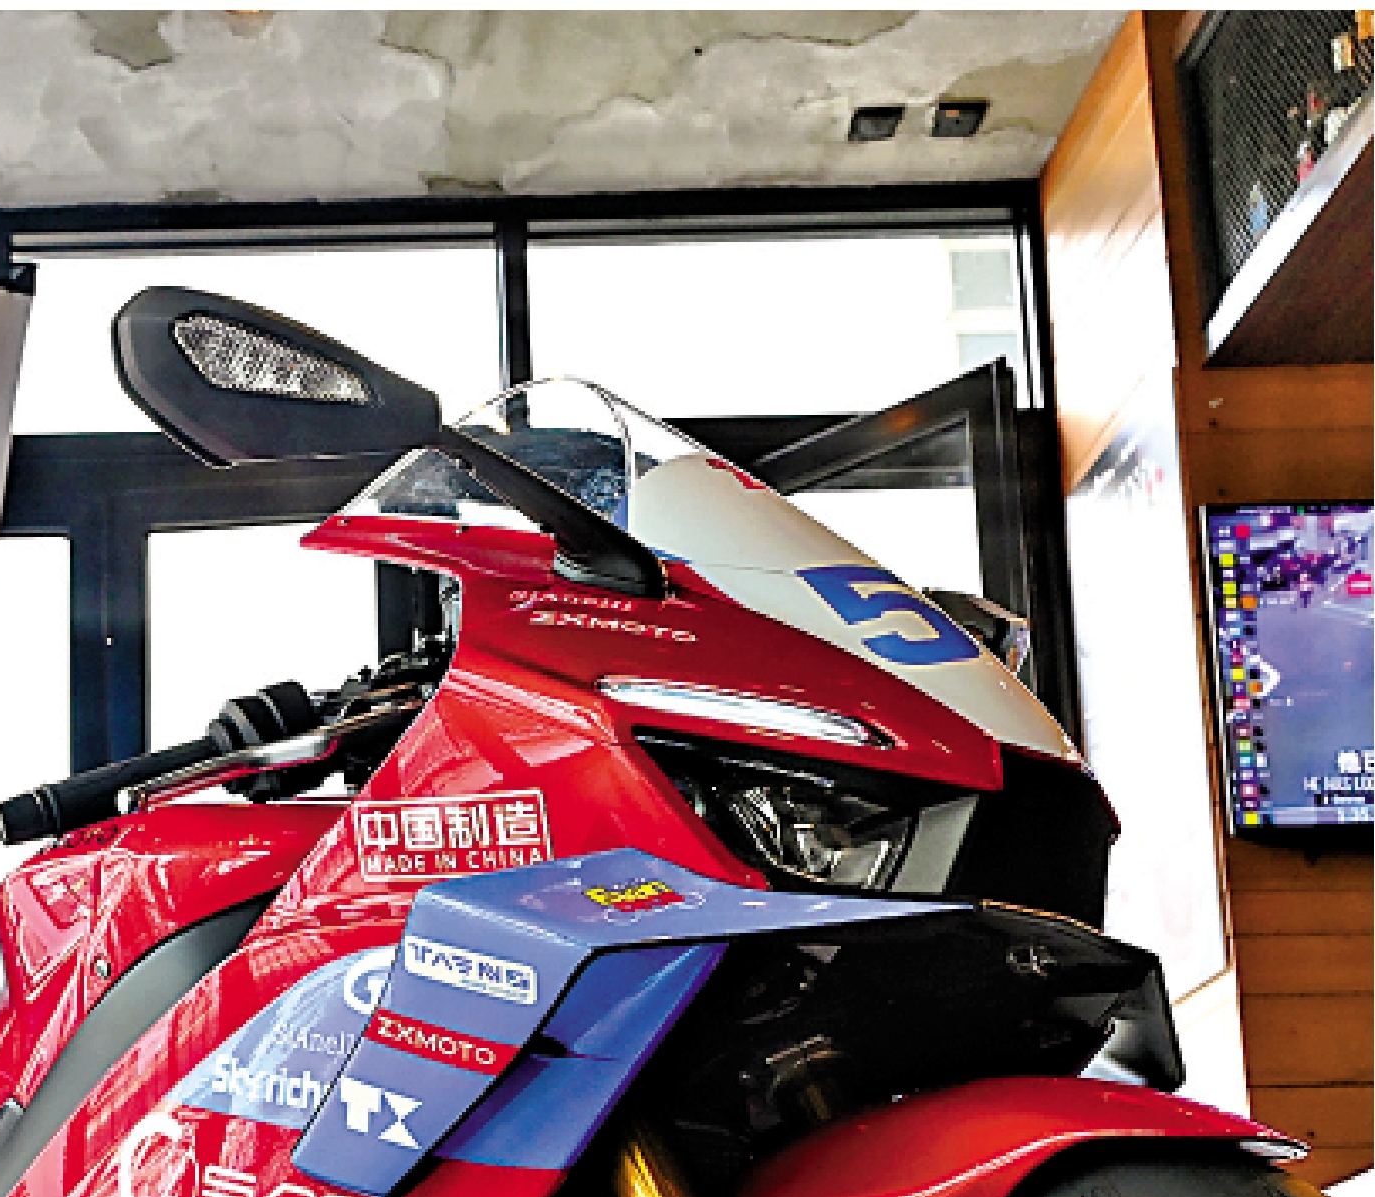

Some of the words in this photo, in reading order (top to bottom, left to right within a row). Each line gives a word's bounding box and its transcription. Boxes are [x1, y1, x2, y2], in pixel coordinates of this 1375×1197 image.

[529, 610, 698, 643] ZXMOTO
[360, 800, 542, 852] 中国制造
[366, 853, 427, 873] MADE
[434, 853, 458, 870] IN
[466, 847, 544, 870] CHINA
[375, 1015, 498, 1067] ZXMOTO
[211, 1052, 322, 1111] Skyrich
